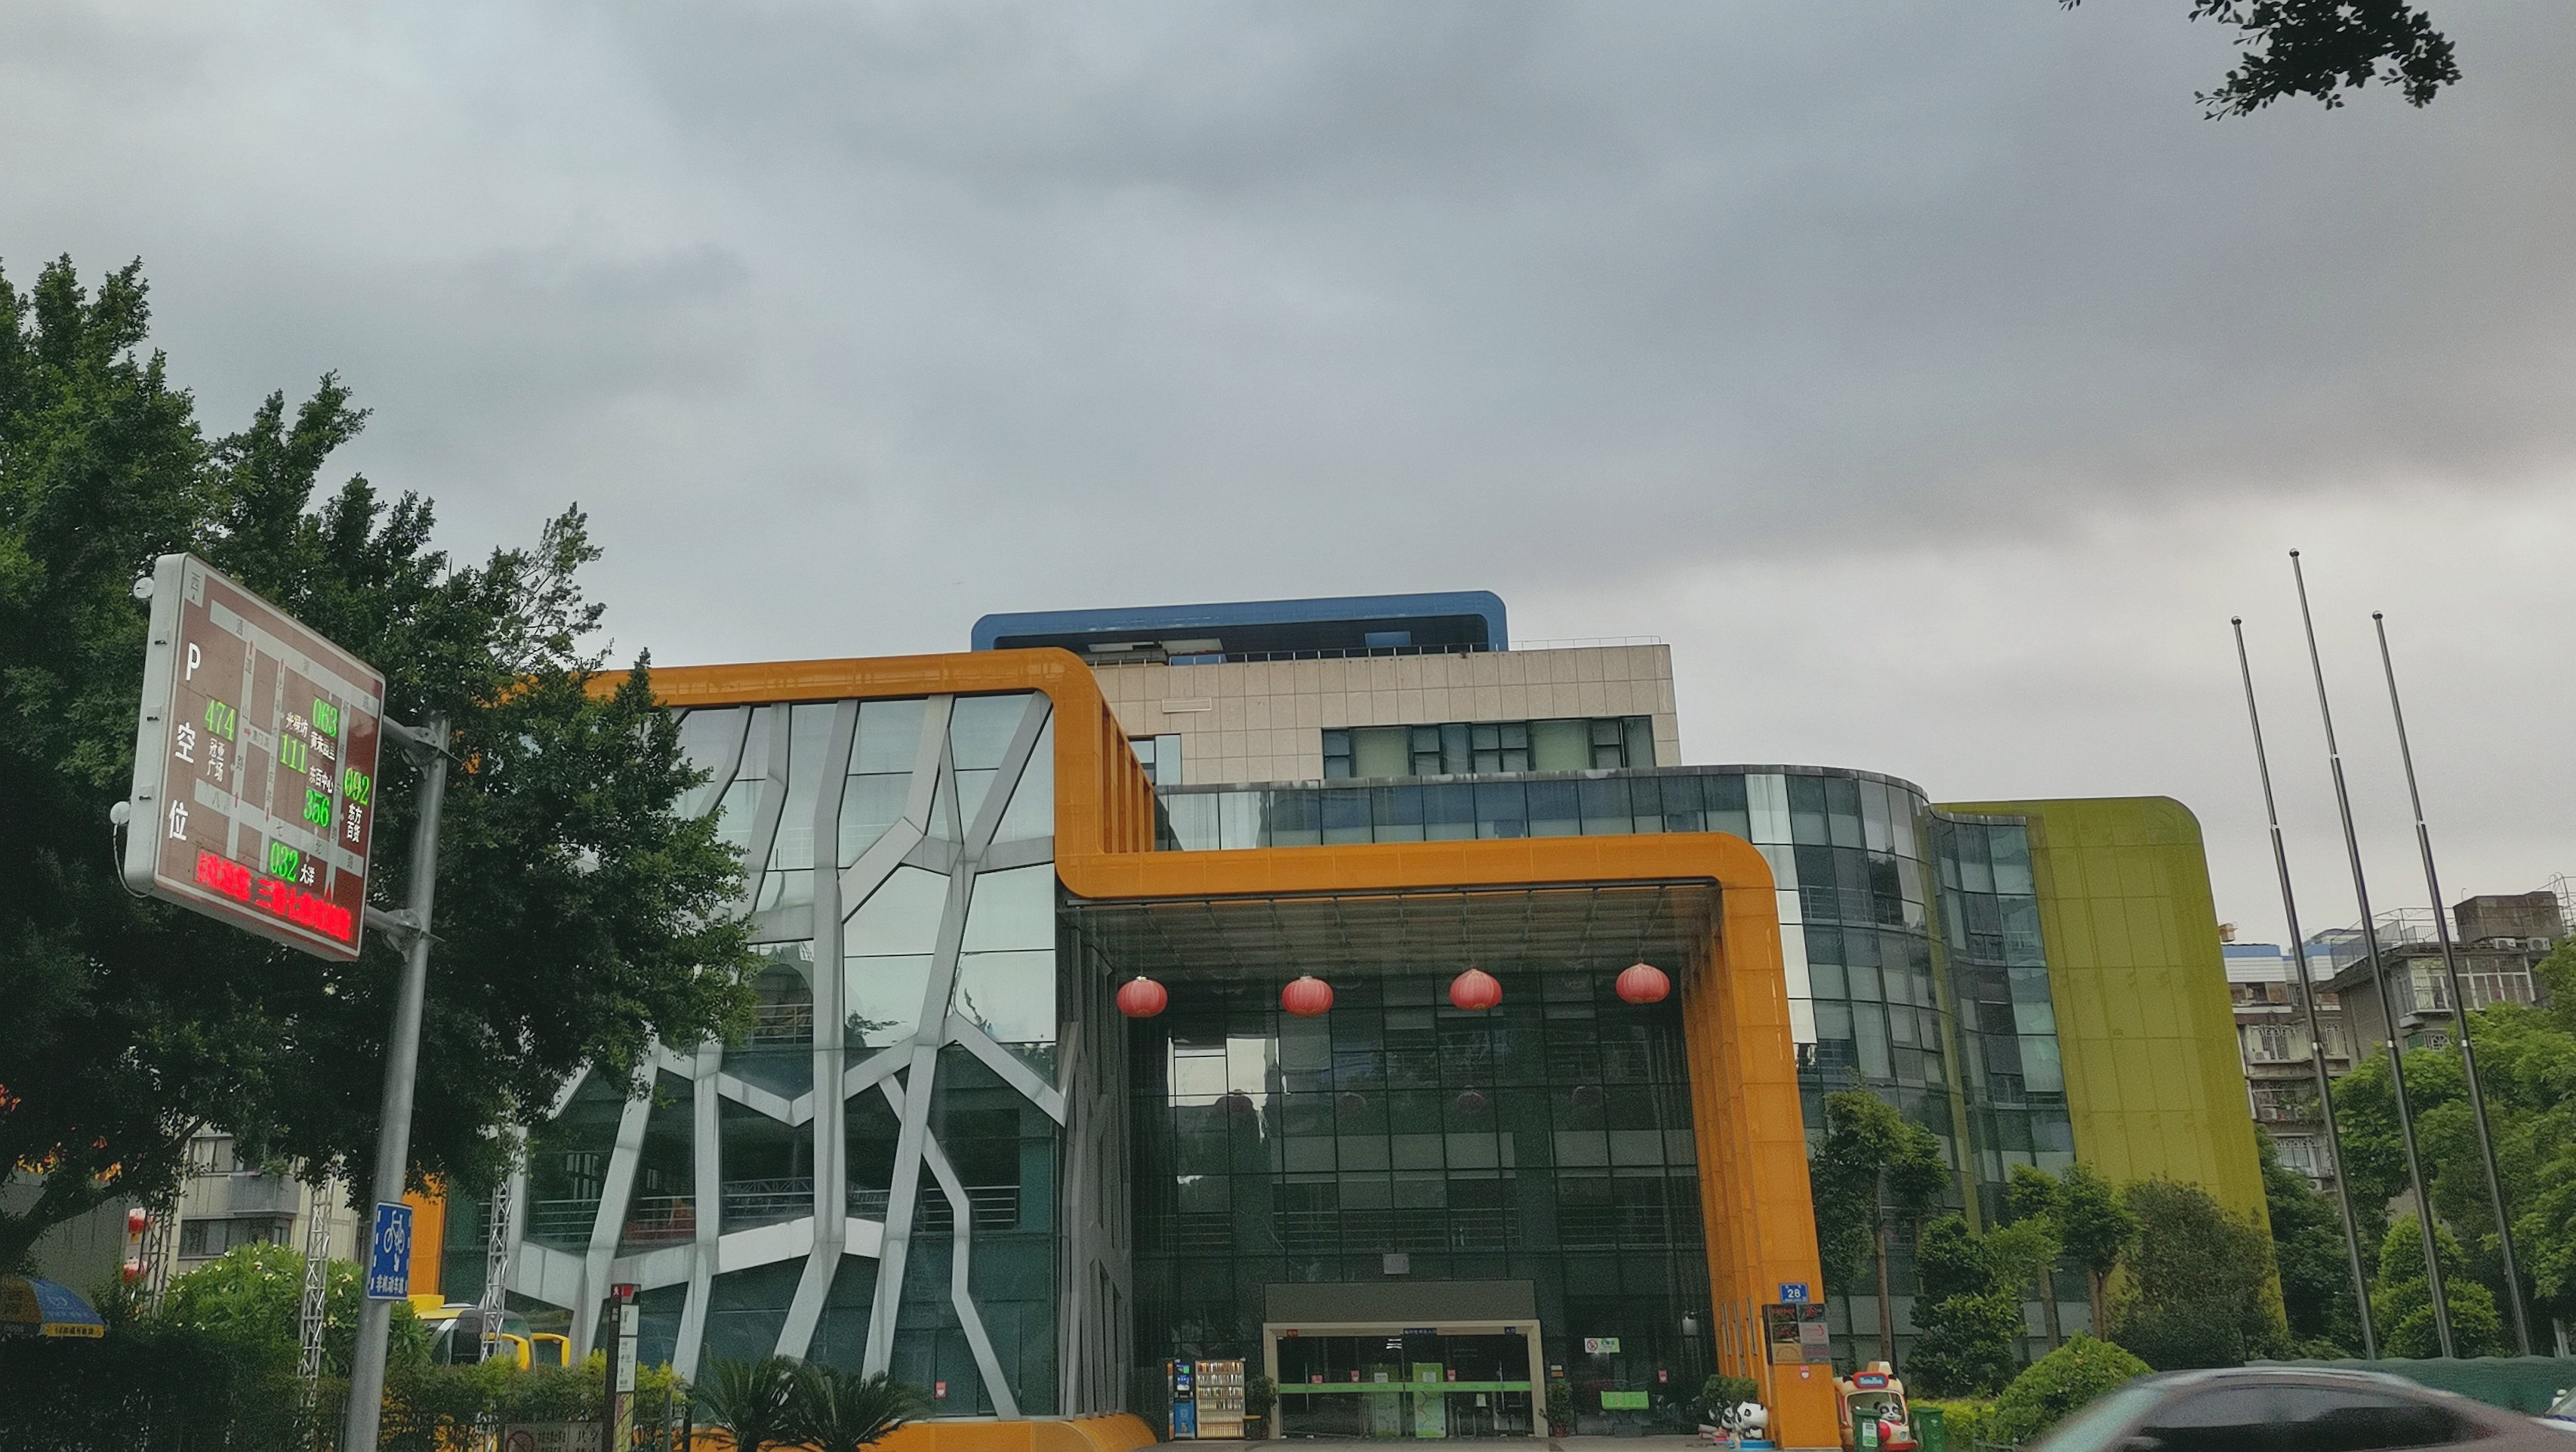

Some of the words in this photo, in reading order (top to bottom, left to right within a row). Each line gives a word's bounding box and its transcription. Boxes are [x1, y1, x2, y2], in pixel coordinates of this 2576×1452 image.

[186, 642, 201, 681] P
[205, 699, 236, 741] 474
[312, 698, 339, 738] 063
[279, 733, 308, 774] 111
[344, 767, 371, 806] 092
[304, 789, 331, 828] 356
[270, 841, 299, 882] 032
[300, 864, 316, 886] 大洋
[1787, 1289, 1801, 1298] 28
